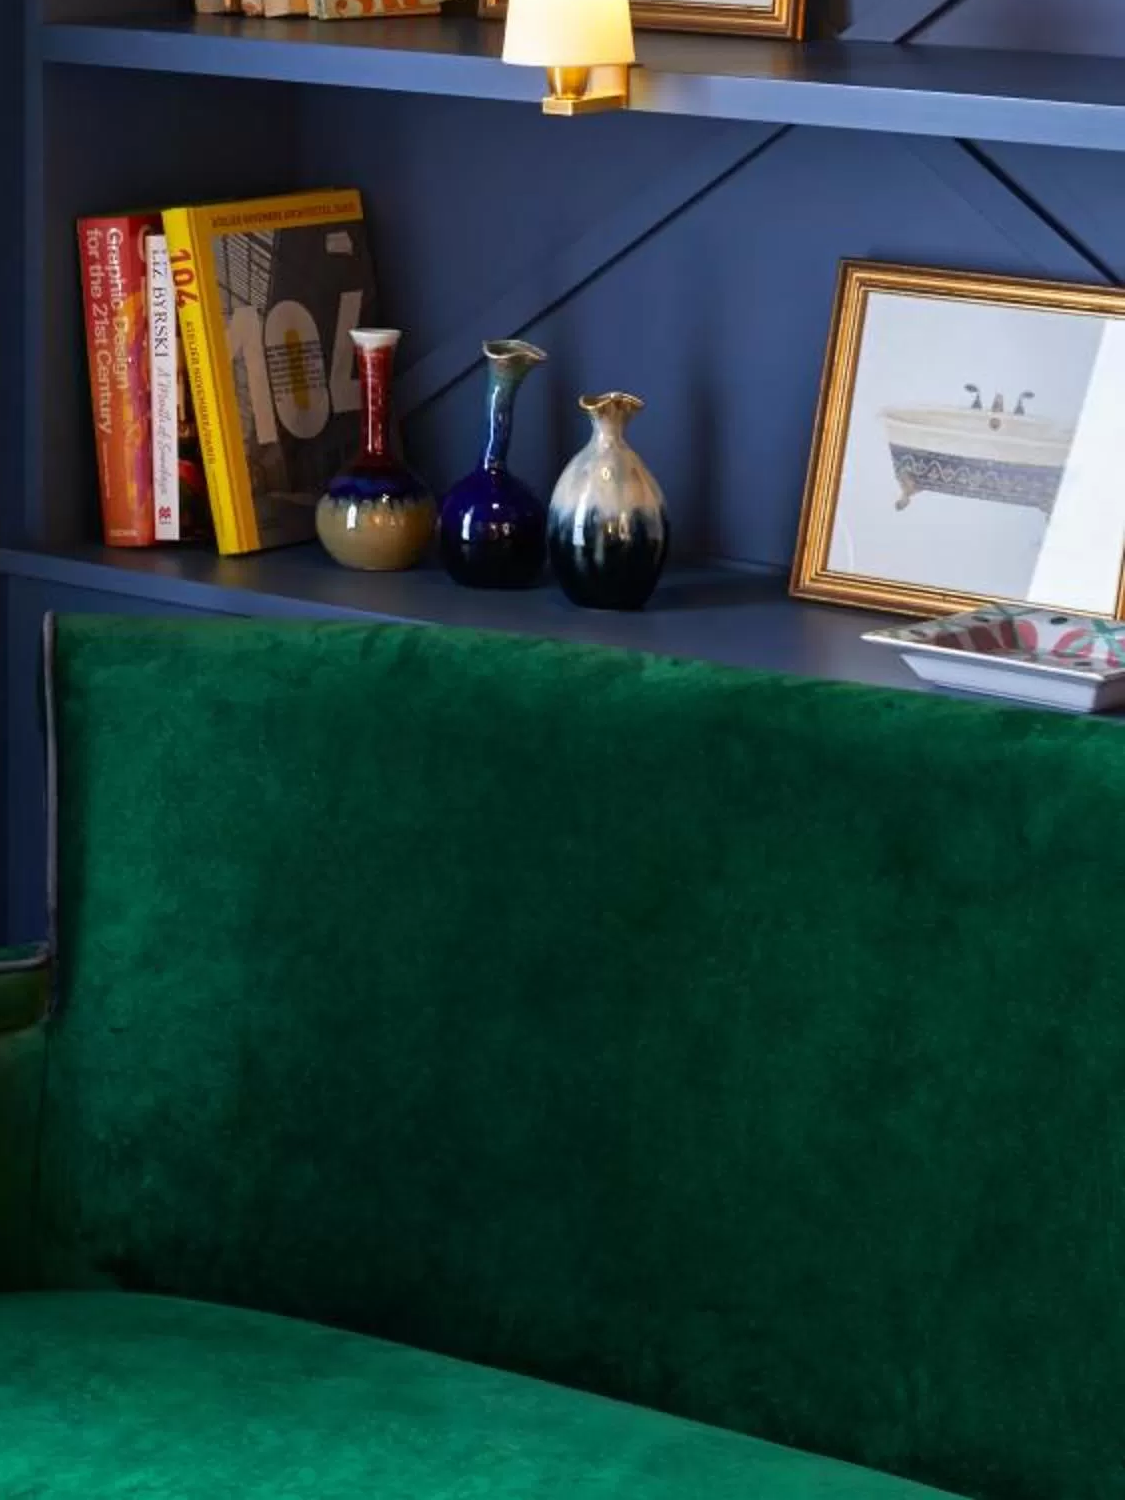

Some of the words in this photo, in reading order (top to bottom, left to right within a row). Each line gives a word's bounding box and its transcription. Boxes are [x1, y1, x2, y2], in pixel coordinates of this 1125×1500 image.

[86, 227, 102, 259] for
[106, 227, 127, 310] Graphic
[89, 265, 105, 299] the
[170, 248, 198, 309] 104
[92, 303, 109, 345] 21st
[112, 315, 131, 389] Design
[152, 287, 169, 358] BYRSKI
[96, 349, 112, 434] Century
